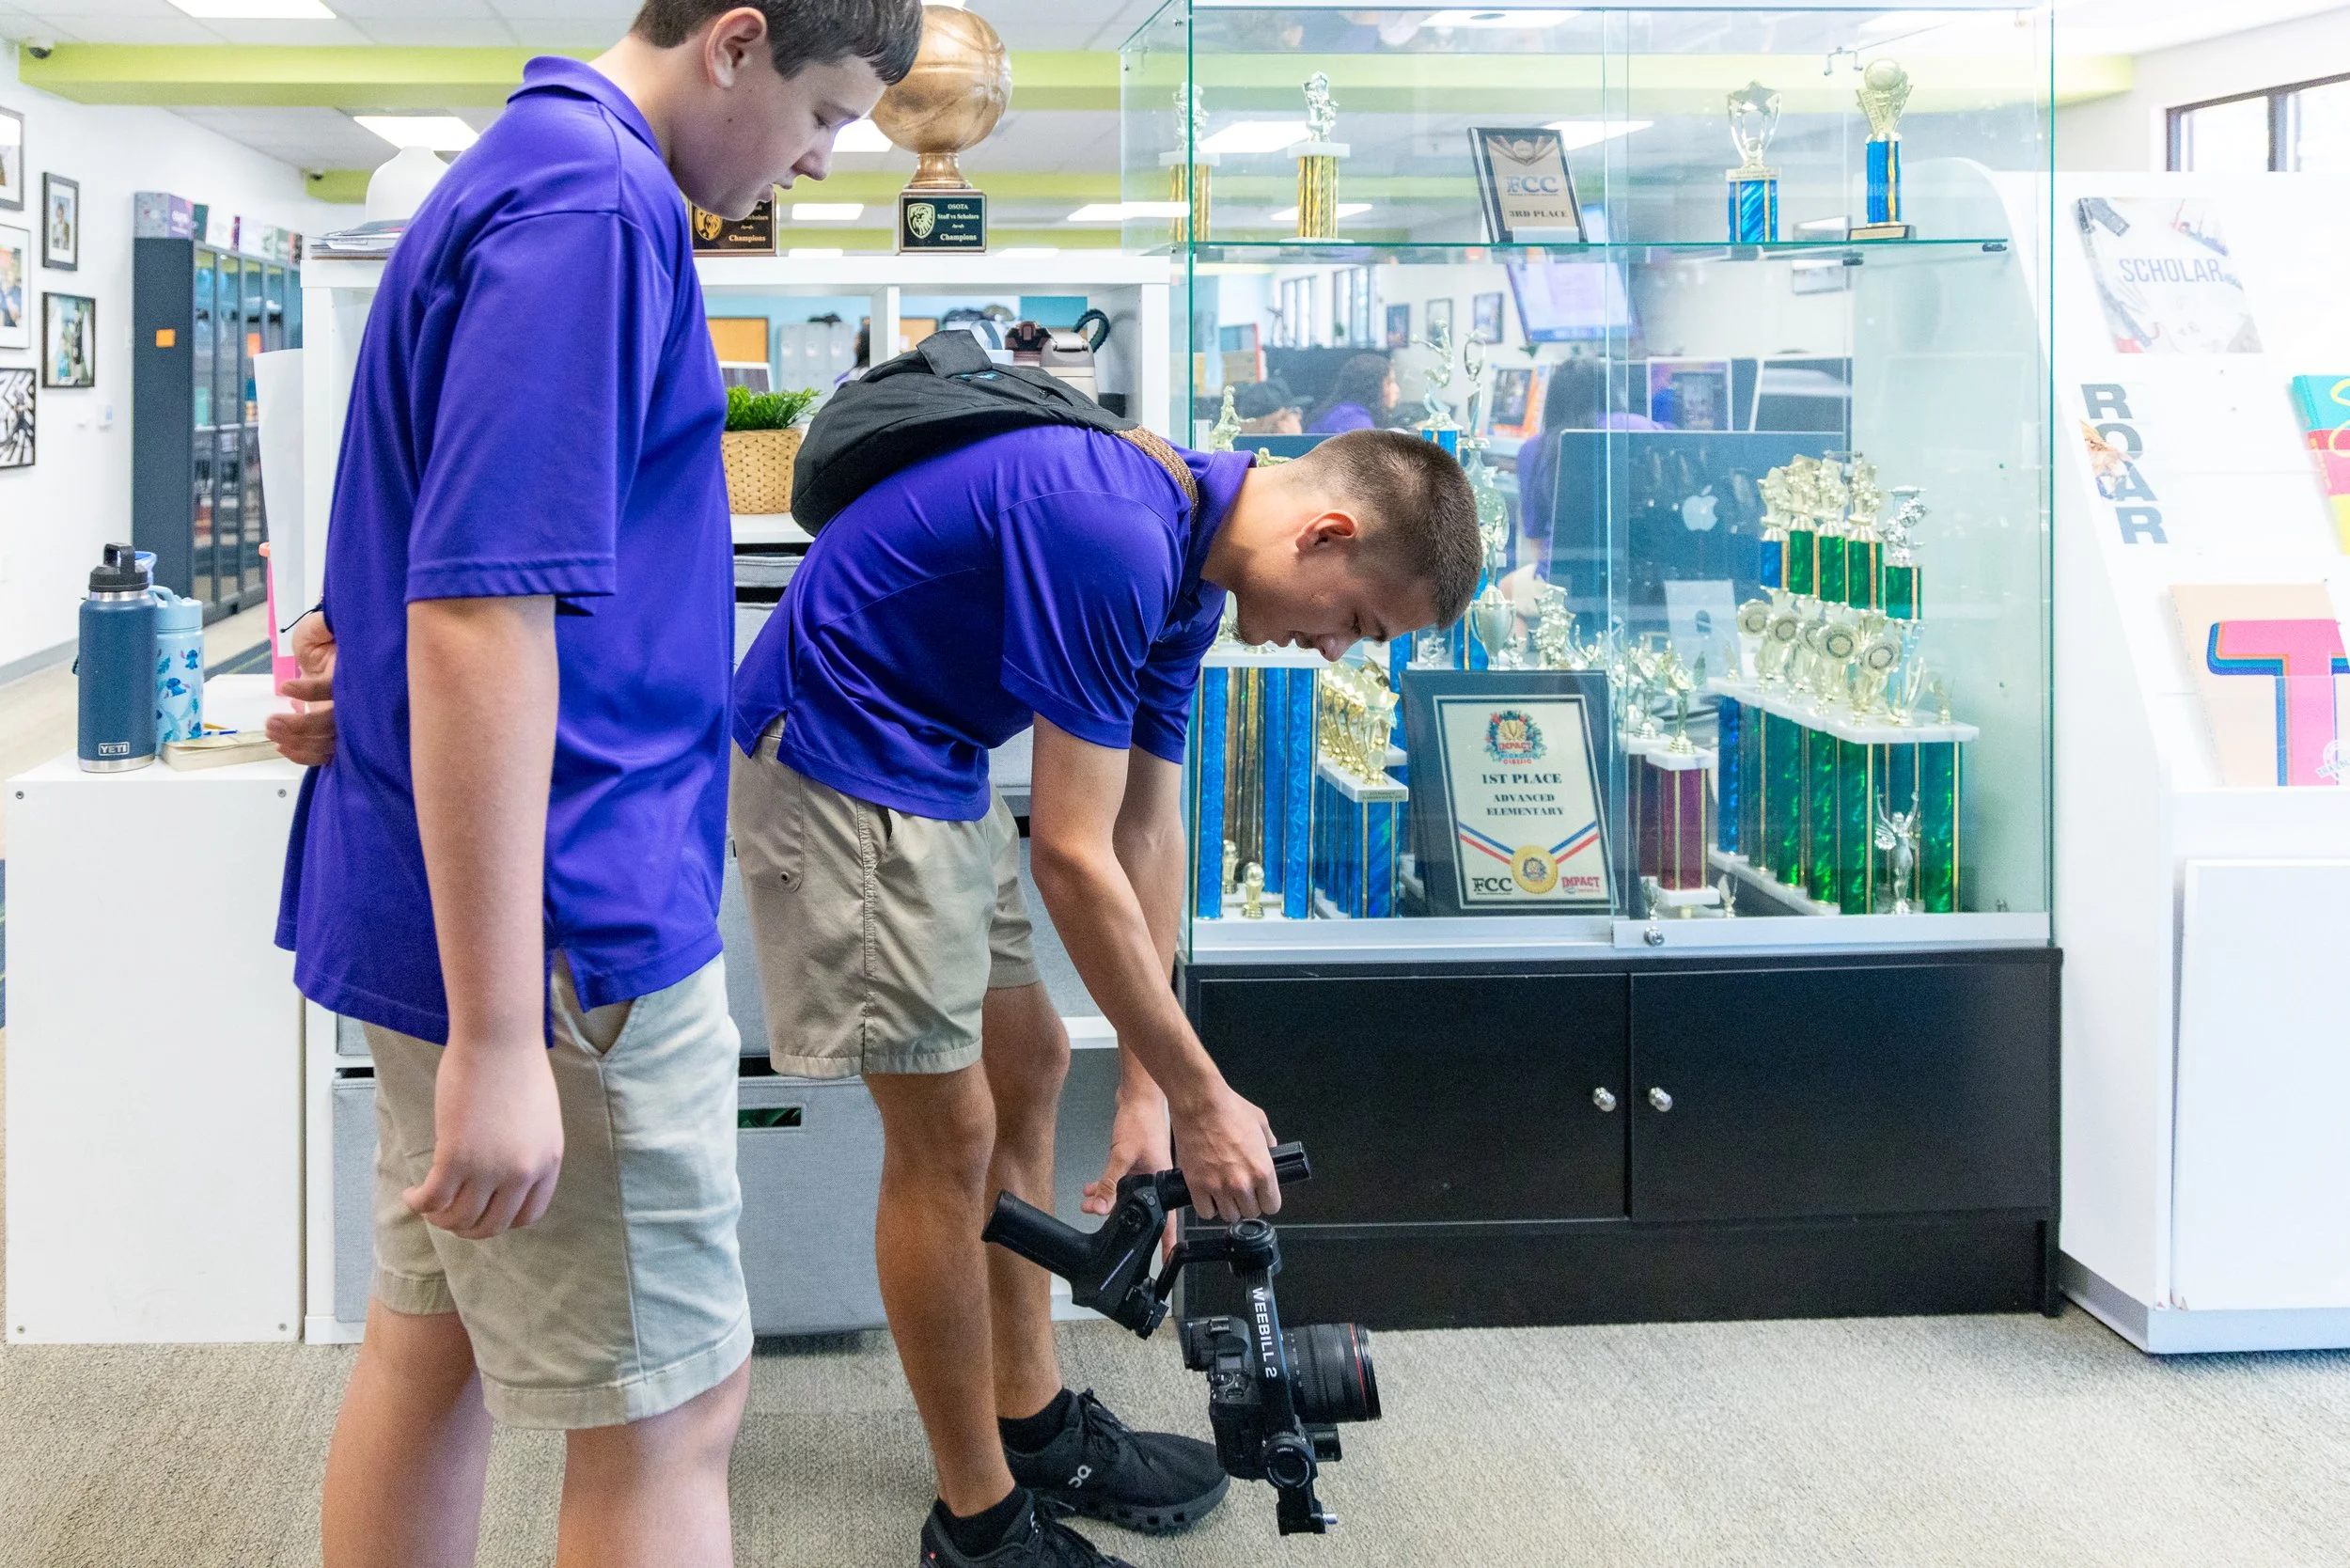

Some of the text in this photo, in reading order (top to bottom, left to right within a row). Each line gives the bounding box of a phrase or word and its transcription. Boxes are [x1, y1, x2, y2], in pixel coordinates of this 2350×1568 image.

[1504, 175, 1559, 194] FCC
[1508, 210, 1567, 218] 3RD PLACE
[728, 234, 766, 243] Champions
[940, 233, 978, 243] Champions
[2119, 258, 2225, 282] SCHOLAR
[2080, 384, 2169, 544] ROAR
[101, 744, 127, 754] YETI
[1481, 774, 1562, 784] 1ST PLACE
[1494, 793, 1555, 802] ADVANCED
[1486, 808, 1564, 816] ELEMENTARY
[1472, 877, 1512, 892] FCC
[1561, 876, 1600, 887] IMPACT
[1252, 1287, 1277, 1378] WEEBILL 2
